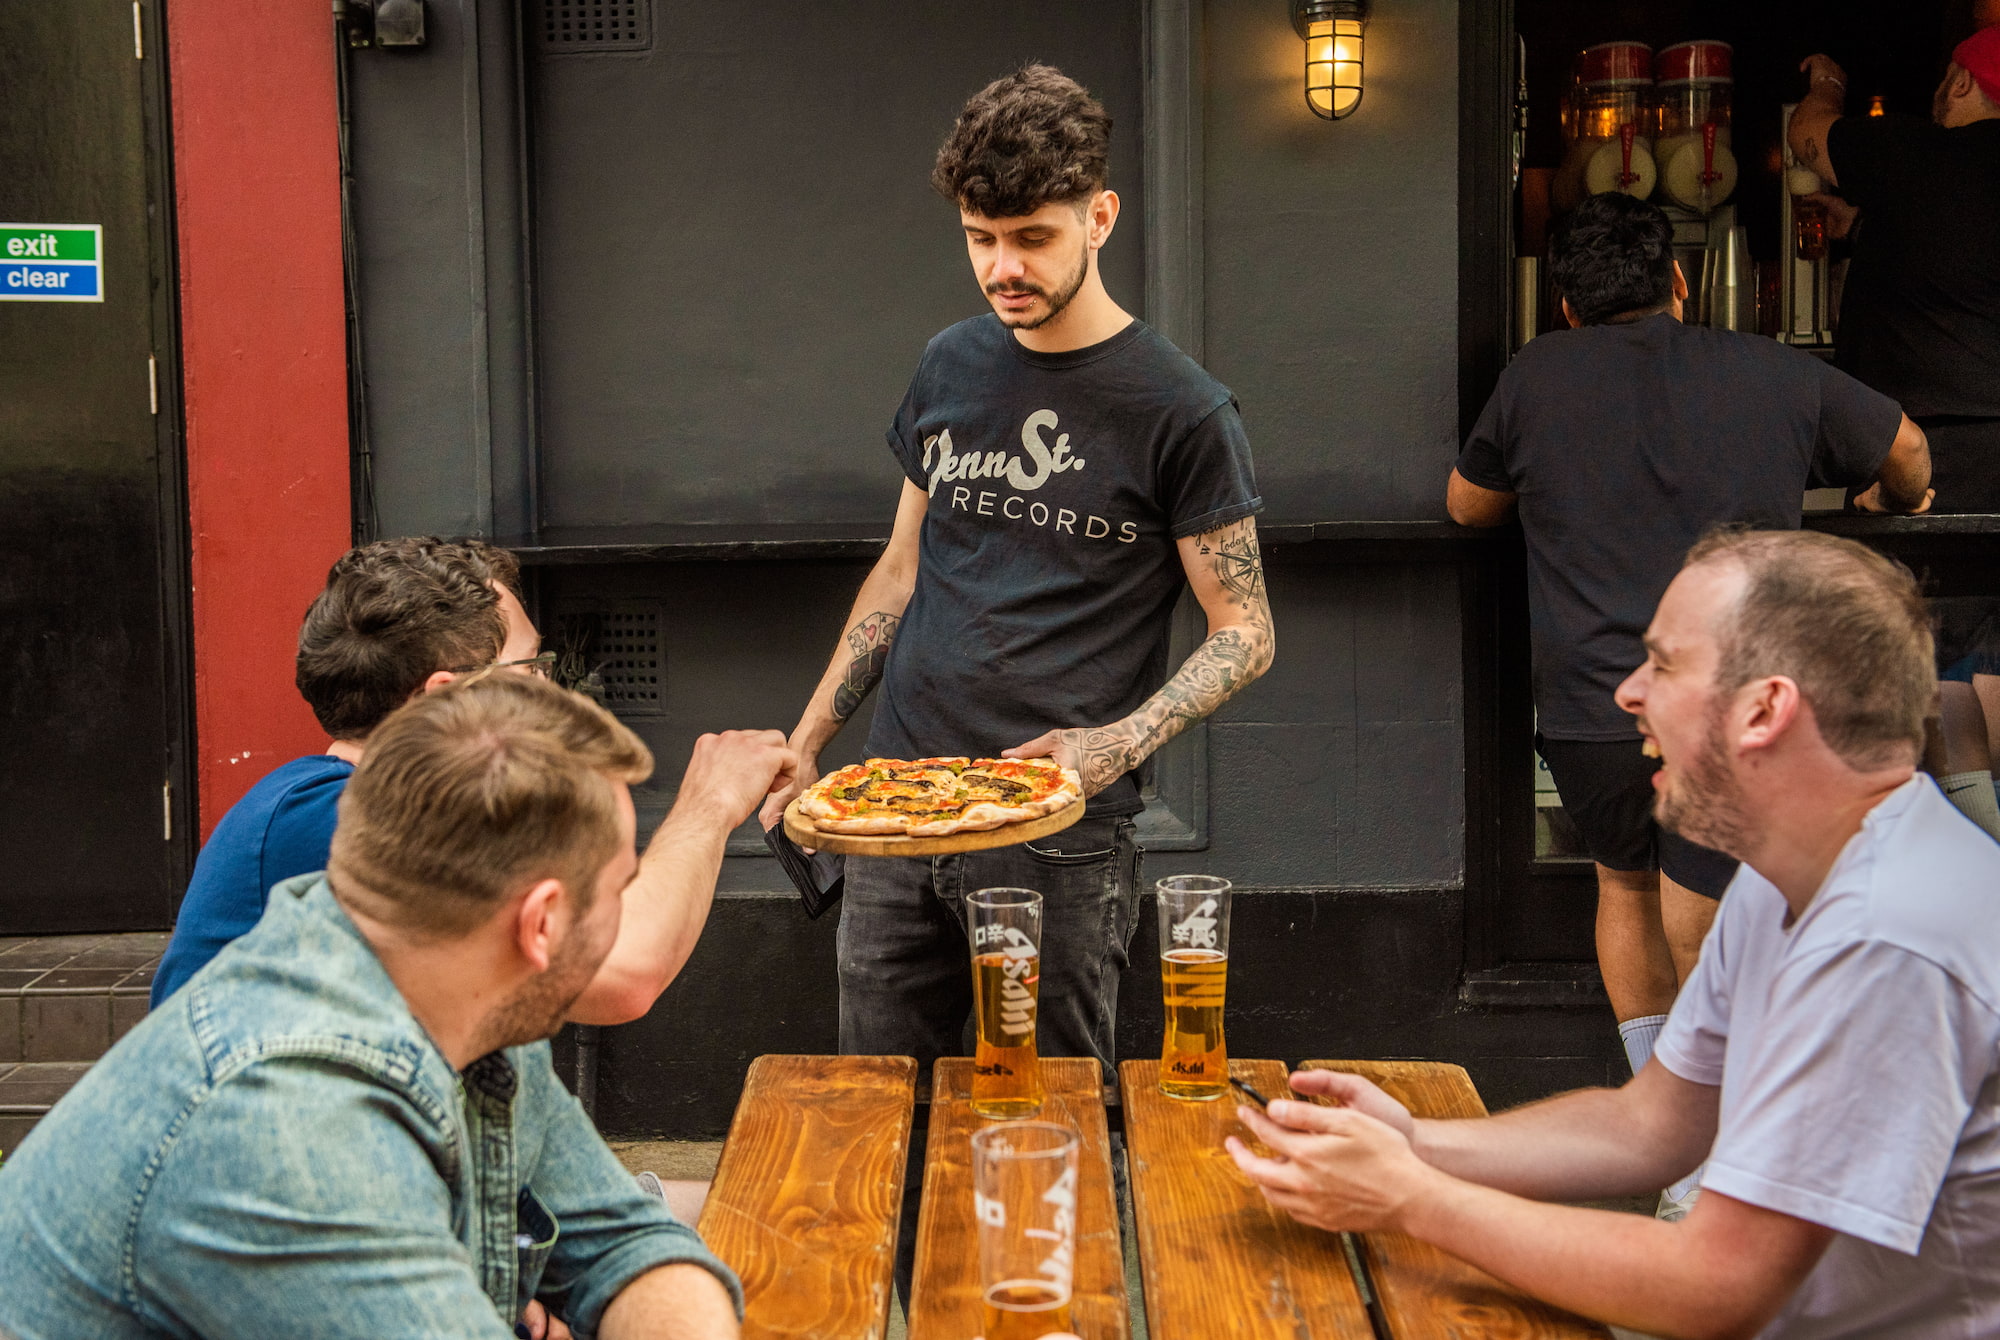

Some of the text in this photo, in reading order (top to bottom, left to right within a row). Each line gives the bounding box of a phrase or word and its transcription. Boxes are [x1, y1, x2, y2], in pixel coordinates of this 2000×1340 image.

[7, 233, 58, 257] exit
[7, 266, 70, 288] clear
[951, 486, 1138, 543] RECORDS
[1000, 927, 1038, 1035] Asahi
